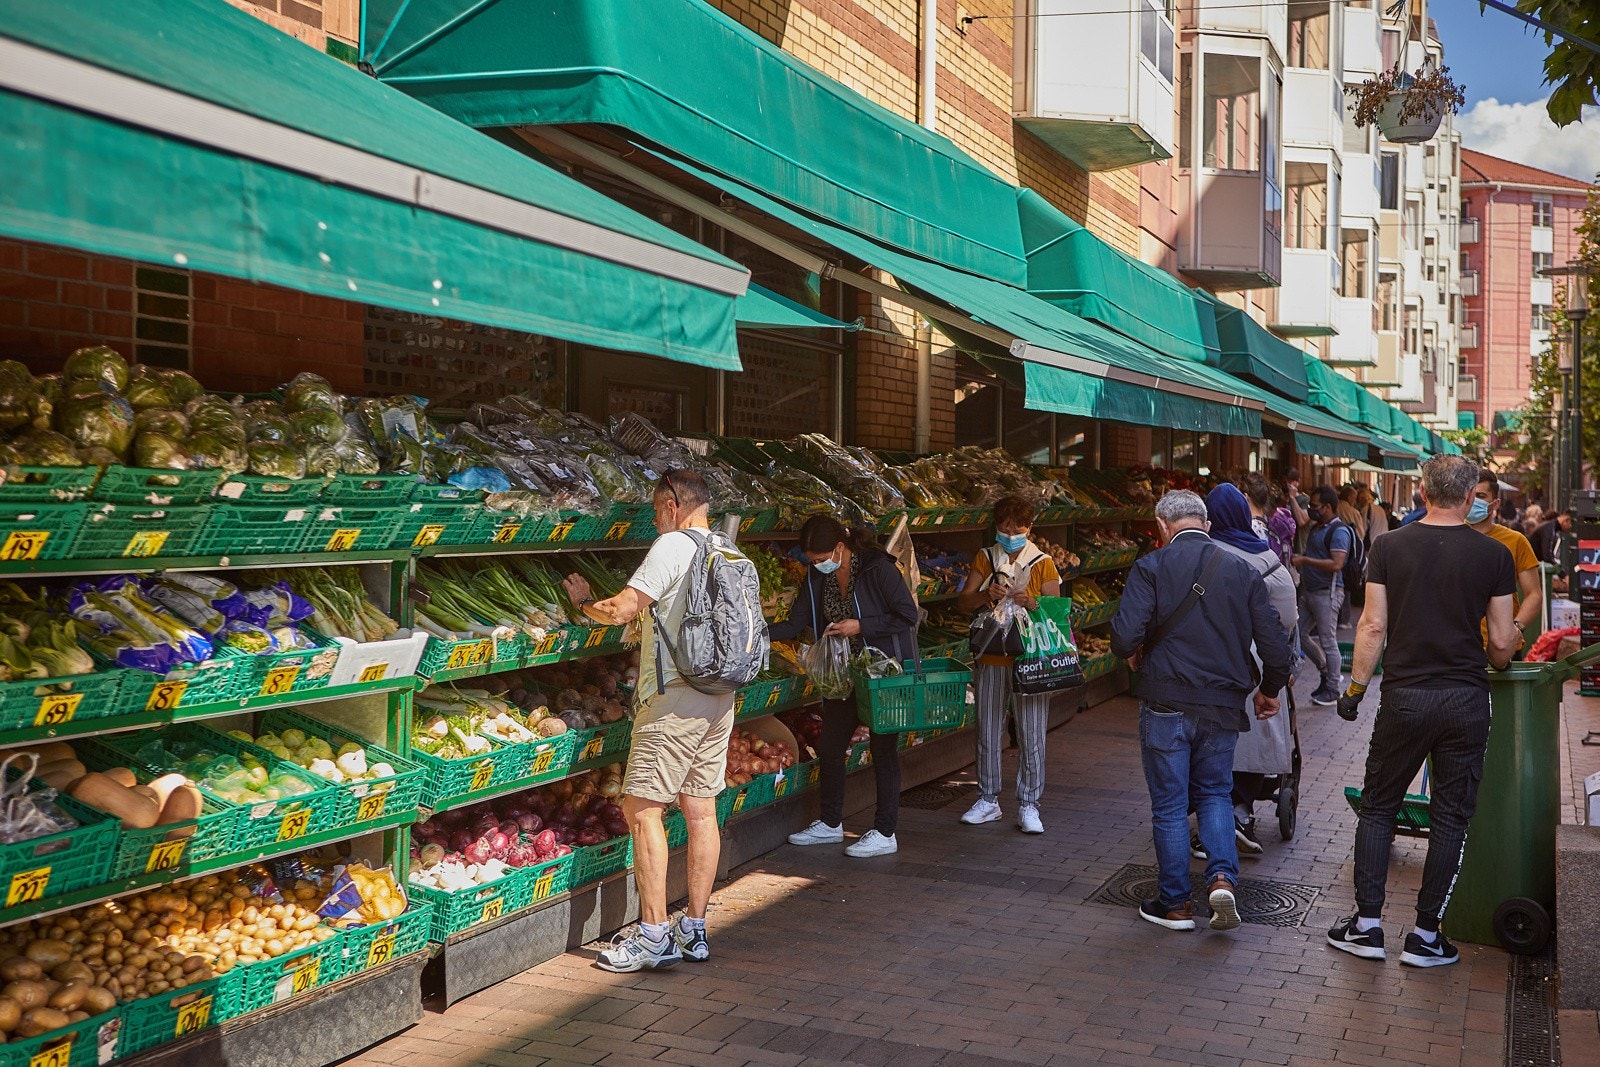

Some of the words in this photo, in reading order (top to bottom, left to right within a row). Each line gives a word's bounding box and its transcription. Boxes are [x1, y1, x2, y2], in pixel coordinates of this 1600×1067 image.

[8, 539, 34, 559] 19
[1018, 661, 1043, 674] Sport
[266, 673, 284, 695] 8
[154, 687, 173, 710] 8
[358, 799, 379, 820] 39
[282, 816, 304, 840] 39
[154, 847, 175, 870] 16
[373, 944, 390, 966] 59
[181, 1012, 202, 1032] 24
